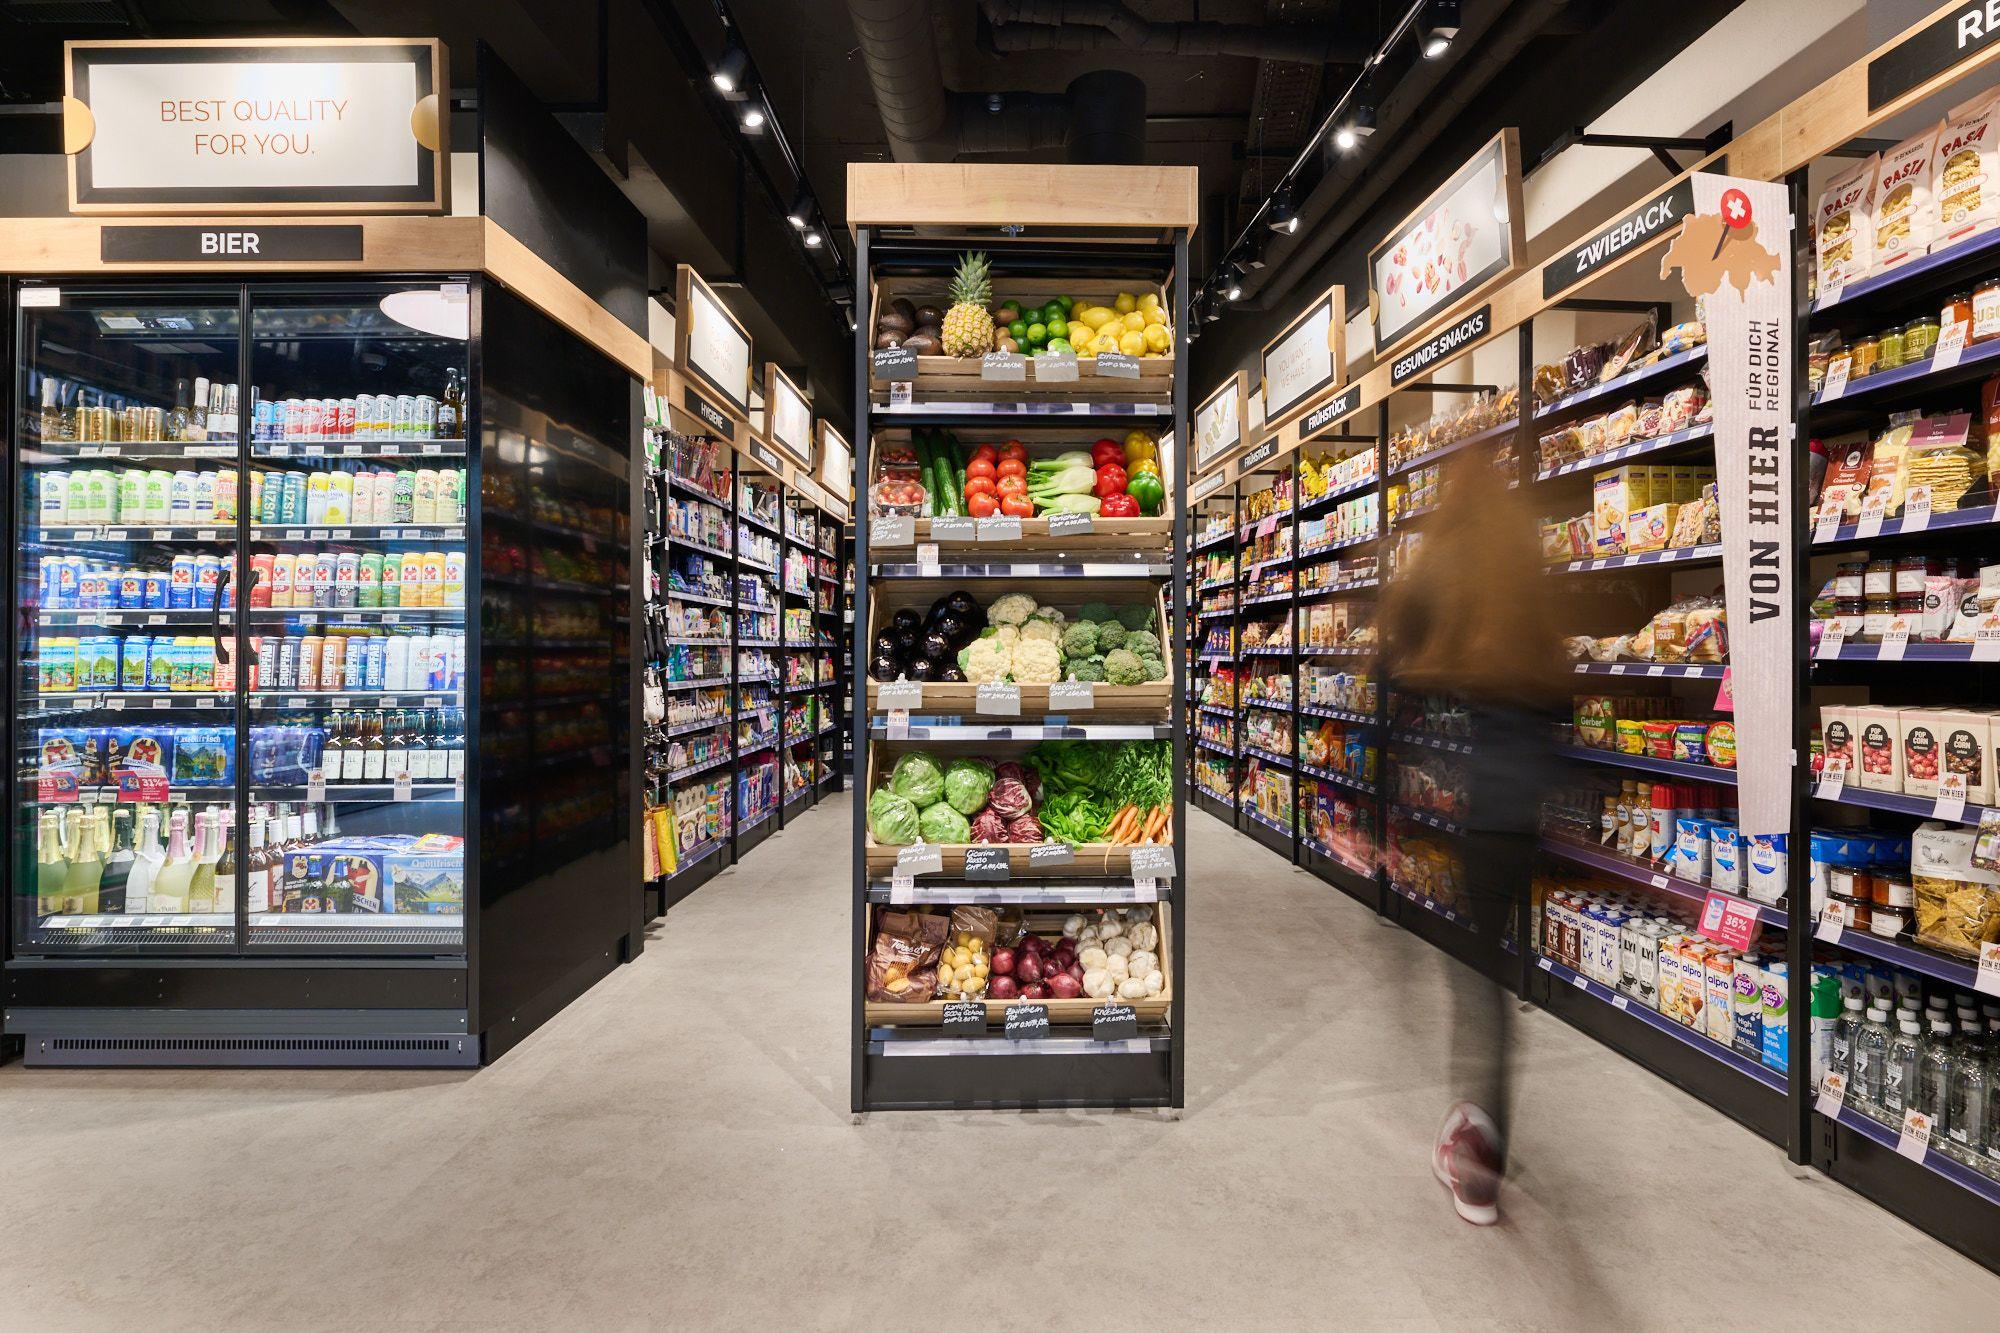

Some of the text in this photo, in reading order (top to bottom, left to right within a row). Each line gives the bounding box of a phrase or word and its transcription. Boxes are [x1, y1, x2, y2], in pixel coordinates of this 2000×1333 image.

[161, 100, 349, 122] BEST QUALITY
[194, 134, 316, 155] FOR YOU.
[1883, 158, 1926, 190] PASTA
[1576, 195, 1674, 273] ZWIEBACK
[201, 233, 260, 254] BIER
[1394, 314, 1484, 380] GESUNDE SNACKS
[1746, 320, 1762, 411] FÜR DICH
[1766, 317, 1779, 411] REGIONAL
[701, 402, 723, 429] HYGIENE
[1308, 396, 1347, 431] FRÜHSTÜCK
[1749, 426, 1780, 624] VON HIER
[1832, 724, 1843, 732] POP
[1870, 727, 1882, 735] POP
[1914, 731, 1927, 739] POP
[1868, 734, 1883, 742] CORN
[1953, 741, 1971, 749] CORN
[1955, 734, 1969, 742] POP
[1939, 788, 1964, 799] VON HIER
[1546, 906, 1561, 918] alpro
[1563, 914, 1579, 926] alpro
[1581, 921, 1596, 933] alpro
[1725, 914, 1747, 932] 36%
[1598, 927, 1616, 941] alpro
[1641, 947, 1654, 961] LY!
[1660, 953, 1679, 968] alpro
[1682, 962, 1702, 978] alpro
[1707, 974, 1729, 990] alpro
[1735, 978, 1752, 989] good
[1709, 994, 1728, 1009] SOYA
[1737, 1017, 1752, 1030] High
[1764, 1029, 1779, 1041] Milk
[1763, 1038, 1781, 1050] Drink
